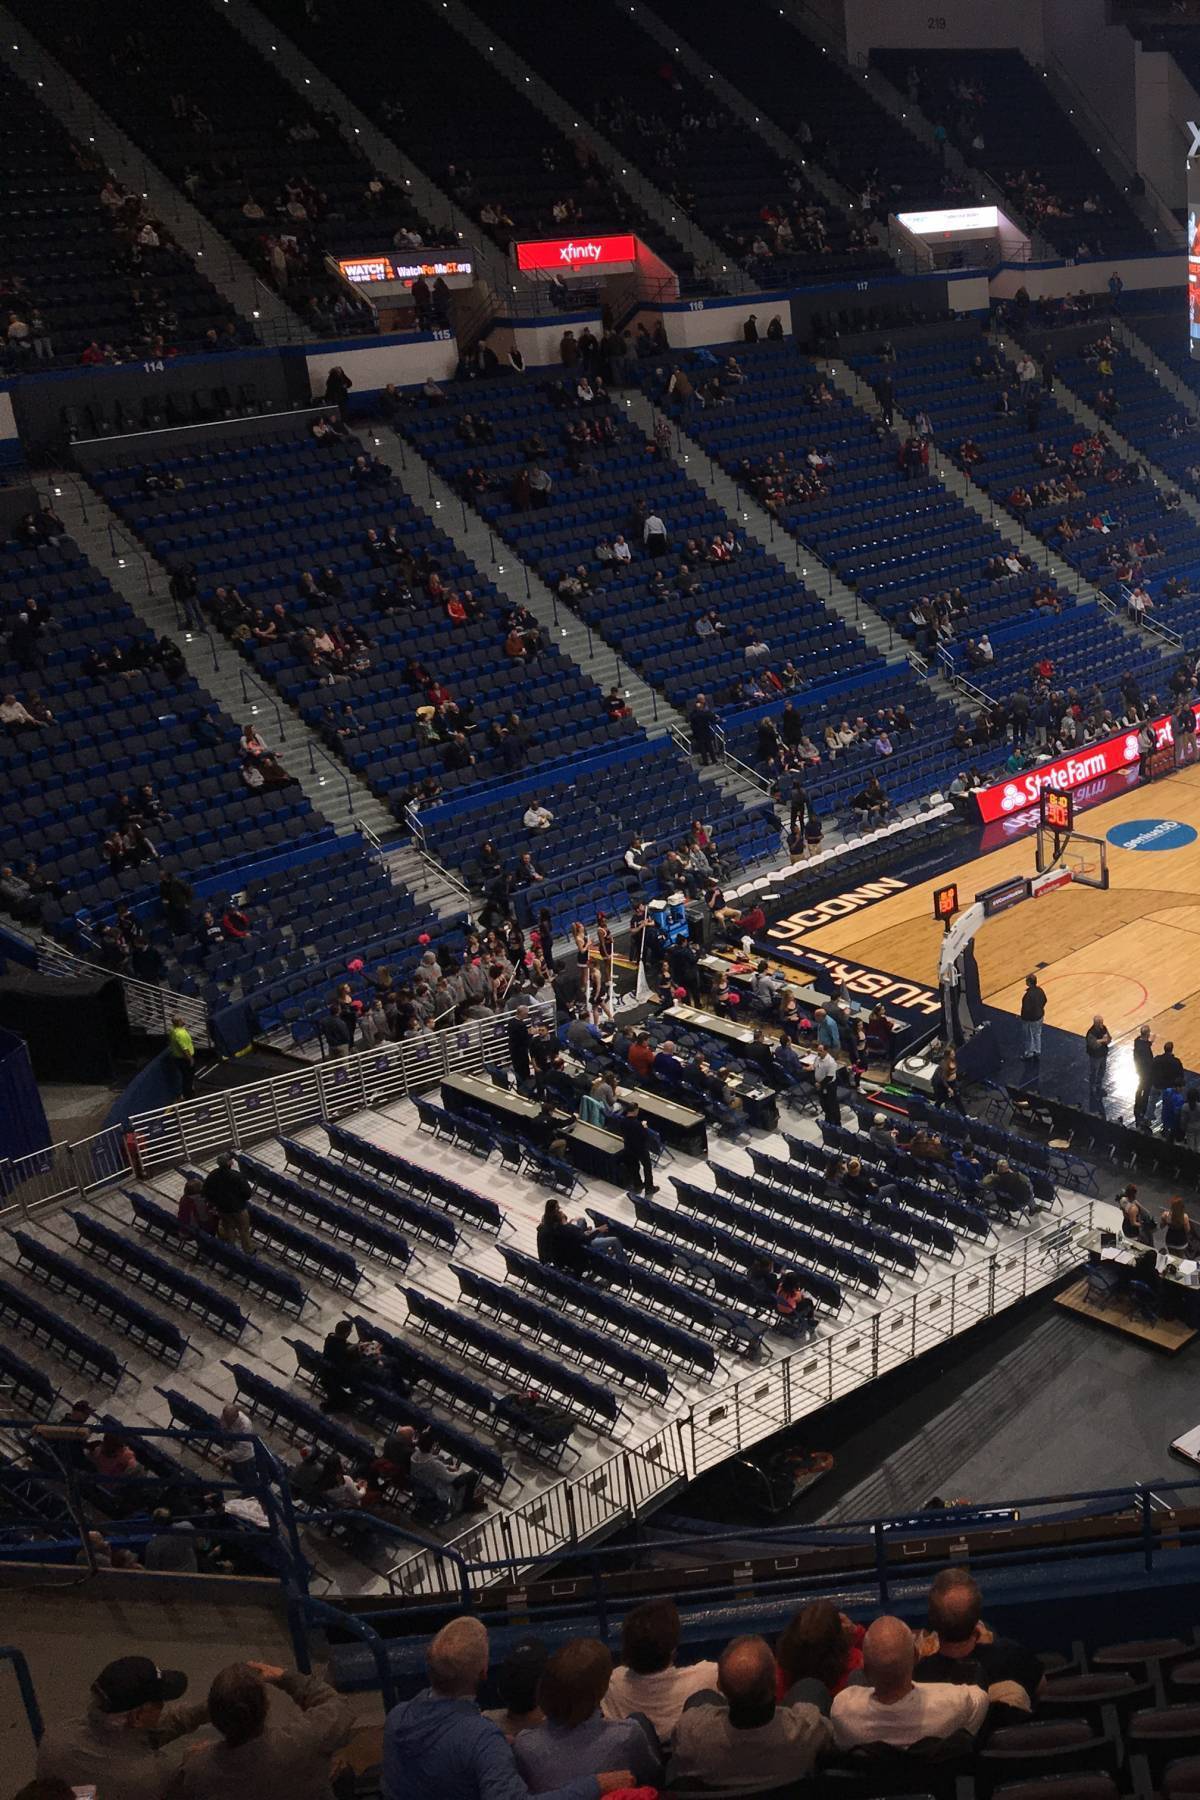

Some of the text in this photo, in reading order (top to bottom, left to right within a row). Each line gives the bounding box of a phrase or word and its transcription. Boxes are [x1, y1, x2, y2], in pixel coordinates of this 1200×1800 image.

[560, 243, 601, 262] xfinity
[345, 264, 384, 276] WATCH
[397, 262, 472, 278] WatchForMeCT.org
[856, 282, 868, 292] 117
[432, 330, 450, 340] 115
[144, 360, 164, 372] 114
[1123, 822, 1178, 851] genius3D
[766, 876, 908, 939] UCONN
